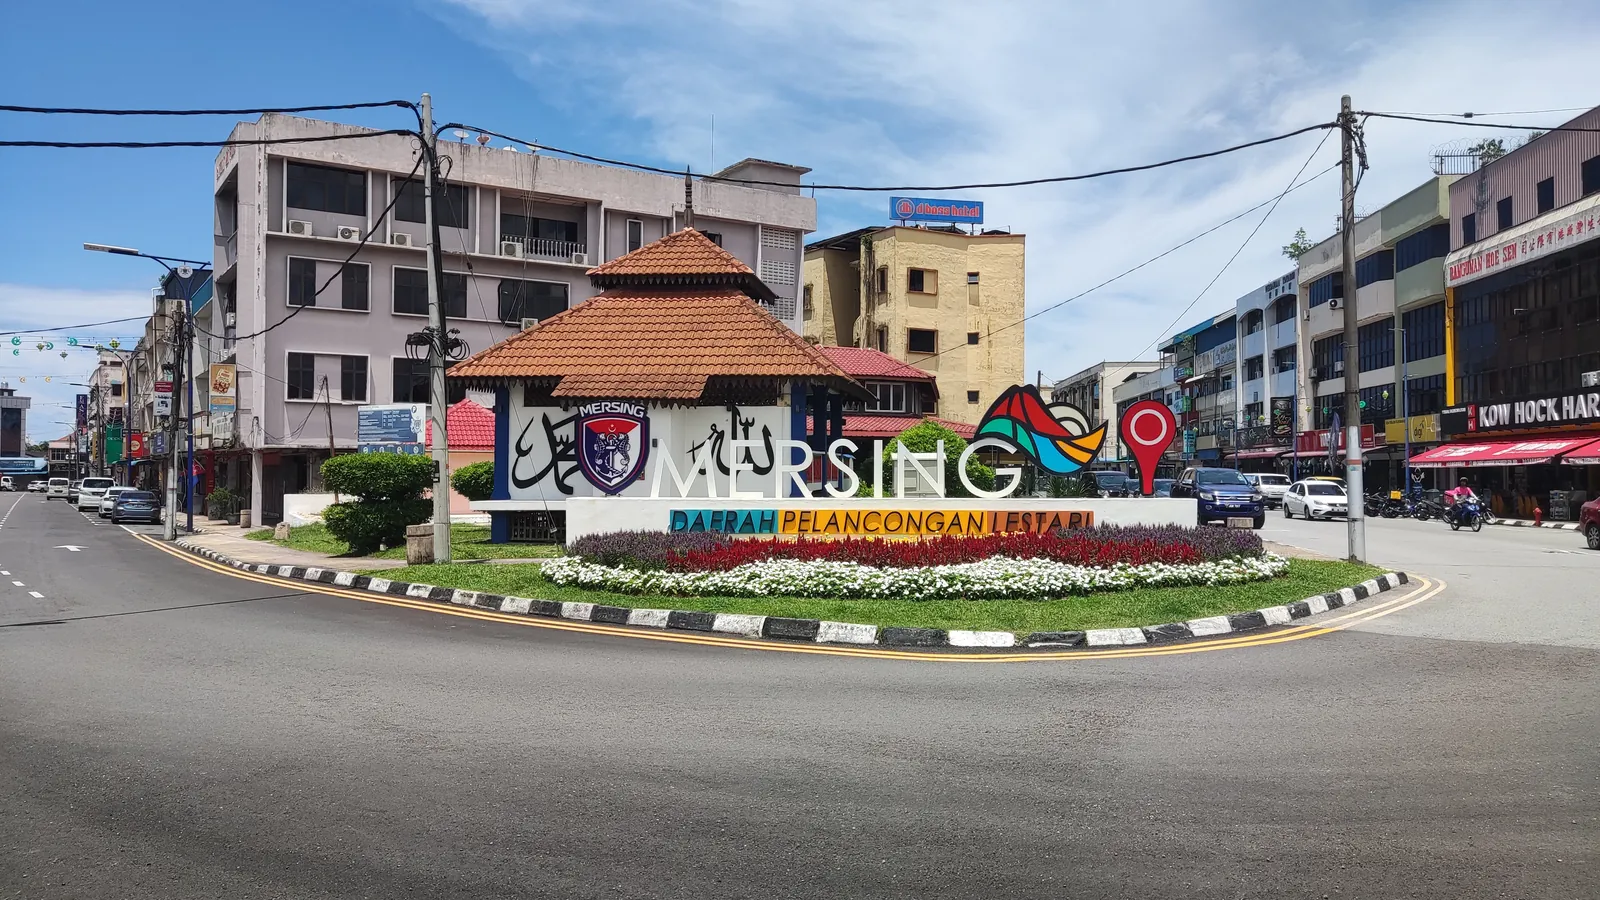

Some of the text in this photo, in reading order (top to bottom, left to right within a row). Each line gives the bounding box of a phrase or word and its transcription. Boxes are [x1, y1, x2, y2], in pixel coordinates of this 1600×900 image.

[925, 204, 950, 216] boss
[951, 205, 980, 217] hotel
[1449, 242, 1517, 281] BANGUNAN HOE SEN
[579, 402, 645, 418] MERSING
[1479, 403, 1511, 428] KOW
[1514, 397, 1559, 424] HOCK
[650, 438, 1022, 499] MERSING
[670, 510, 775, 533] DAERAH
[782, 510, 985, 533] PELANCONGAN
